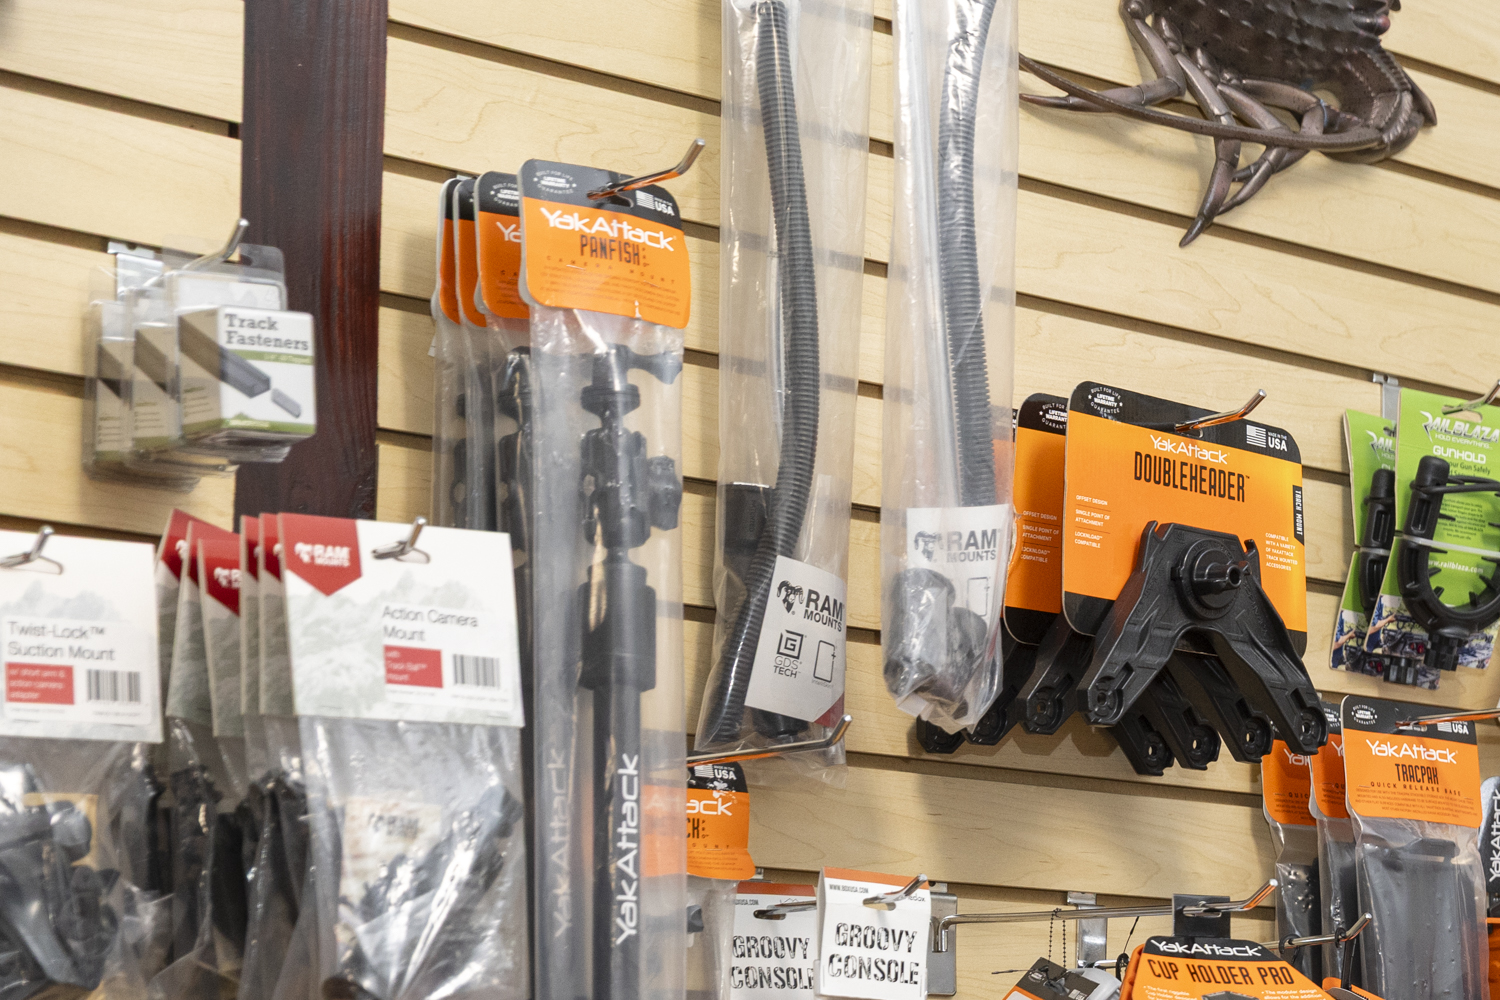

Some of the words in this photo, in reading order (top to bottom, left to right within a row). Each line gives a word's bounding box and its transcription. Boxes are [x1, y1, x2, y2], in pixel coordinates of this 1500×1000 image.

[654, 201, 675, 216] USA
[540, 207, 675, 252] YakAttack
[580, 234, 641, 266] PANFISH
[225, 313, 279, 331] Track
[225, 330, 309, 351] Fasteners
[1267, 437, 1288, 452] USA
[1434, 433, 1450, 442] HOLD
[1150, 434, 1229, 465] YakAttack
[1432, 445, 1487, 465] GUNHOLD
[1459, 462, 1473, 471] Gun
[1473, 464, 1491, 475] Safely
[1075, 494, 1091, 503] OFFSET
[1091, 497, 1108, 506] DESIGN
[1075, 509, 1089, 518] SINGLE
[1089, 511, 1102, 520] POINT
[1075, 516, 1104, 527] ATTACHMENT
[944, 529, 998, 551] RAM
[1074, 539, 1101, 549] COMPATIBLE
[1265, 532, 1290, 542] COMPATIBLE
[315, 545, 351, 558] RAM
[945, 550, 997, 563] MOUNTS
[806, 588, 844, 621] RAM
[382, 606, 423, 623] Action
[427, 609, 479, 629] Camera
[803, 609, 843, 633] MOUNTS
[383, 624, 426, 643] Mount
[8, 641, 64, 659] Suction
[68, 645, 116, 661] Mount
[1452, 724, 1469, 735] USA
[1366, 738, 1457, 766] YakAttack
[714, 769, 737, 781] USA
[1394, 763, 1439, 786] TRACPAK
[1370, 781, 1398, 789] QUICK
[1402, 784, 1438, 793] RELEASE
[1444, 788, 1462, 797] BASE
[616, 752, 640, 946] YakAttack
[835, 922, 918, 953] GROOVY
[732, 935, 810, 960] GROOVY
[1151, 939, 1262, 957] YakAttack
[828, 953, 920, 986] CONSOLE
[1147, 959, 1180, 981] CUP
[1185, 963, 1254, 986] HOLDER
[1257, 966, 1296, 986] PRO
